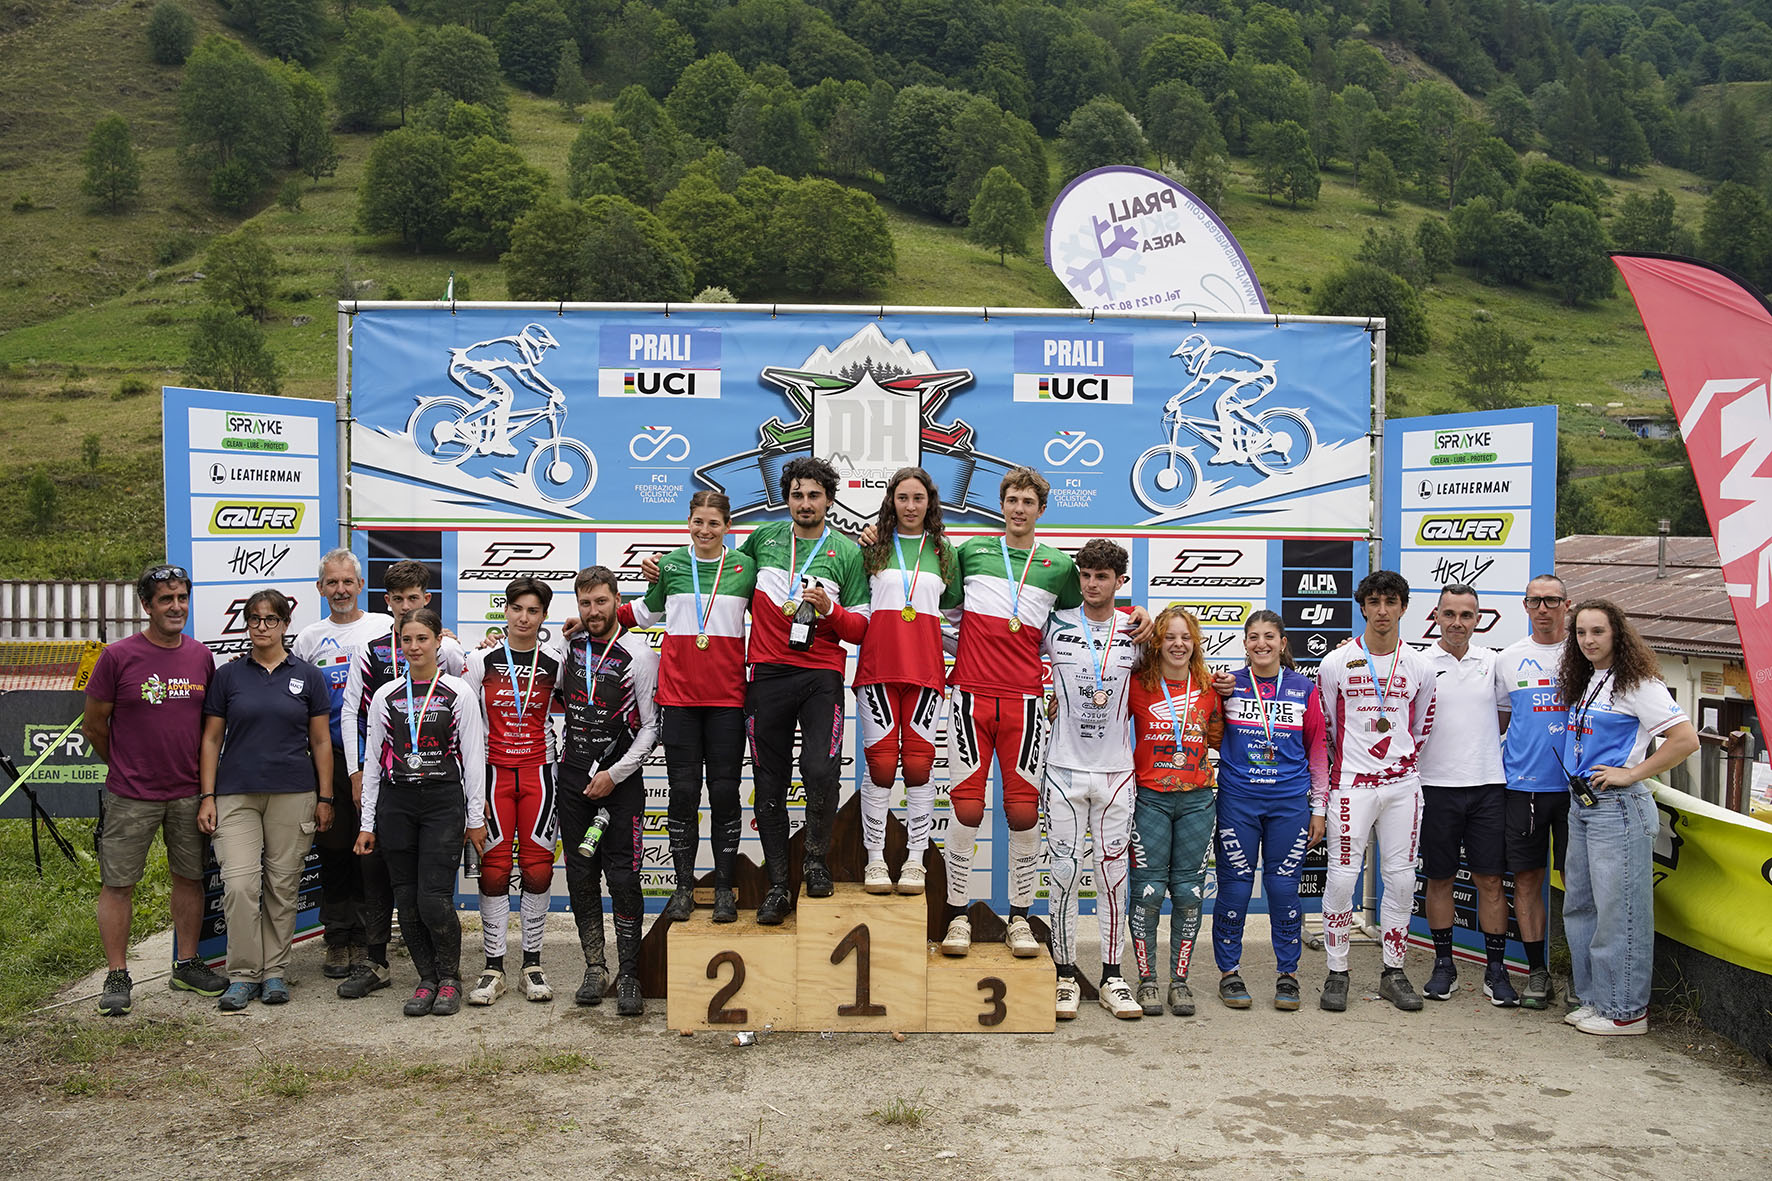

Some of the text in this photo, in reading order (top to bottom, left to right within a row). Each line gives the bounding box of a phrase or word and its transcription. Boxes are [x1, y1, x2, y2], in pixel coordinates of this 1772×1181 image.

[630, 333, 691, 361] PRALI
[1044, 339, 1104, 367] PRALI
[637, 372, 695, 395] UCI
[1052, 378, 1108, 400] UCI
[229, 417, 283, 435] SPRAYKE
[827, 399, 909, 462] DH
[226, 440, 244, 448] CLEAN
[263, 443, 285, 451] PROTECT
[1437, 431, 1492, 449] SPRAYKE
[1470, 454, 1492, 462] PROTECT
[231, 468, 300, 483] LEATHERMAN
[651, 474, 667, 483] FCI
[1066, 479, 1081, 487] FCI
[1437, 480, 1510, 495] LEATHERMAN
[215, 506, 298, 530] GALFER
[1422, 518, 1504, 541] GALFER
[459, 569, 578, 581] PROGRIP
[1150, 576, 1265, 588] PROGRIP
[1297, 574, 1337, 590] ALPA
[1056, 633, 1133, 648] BLACK
[72, 770, 99, 779] LUBE
[1248, 767, 1278, 776] RACER
[1340, 797, 1350, 821] BAD
[1219, 827, 1253, 876] KENNY
[1276, 826, 1309, 877] KENNY
[1340, 835, 1350, 866] RIDER
[830, 923, 887, 1017] 1
[706, 951, 748, 1024] 2
[977, 976, 1007, 1026] 3
